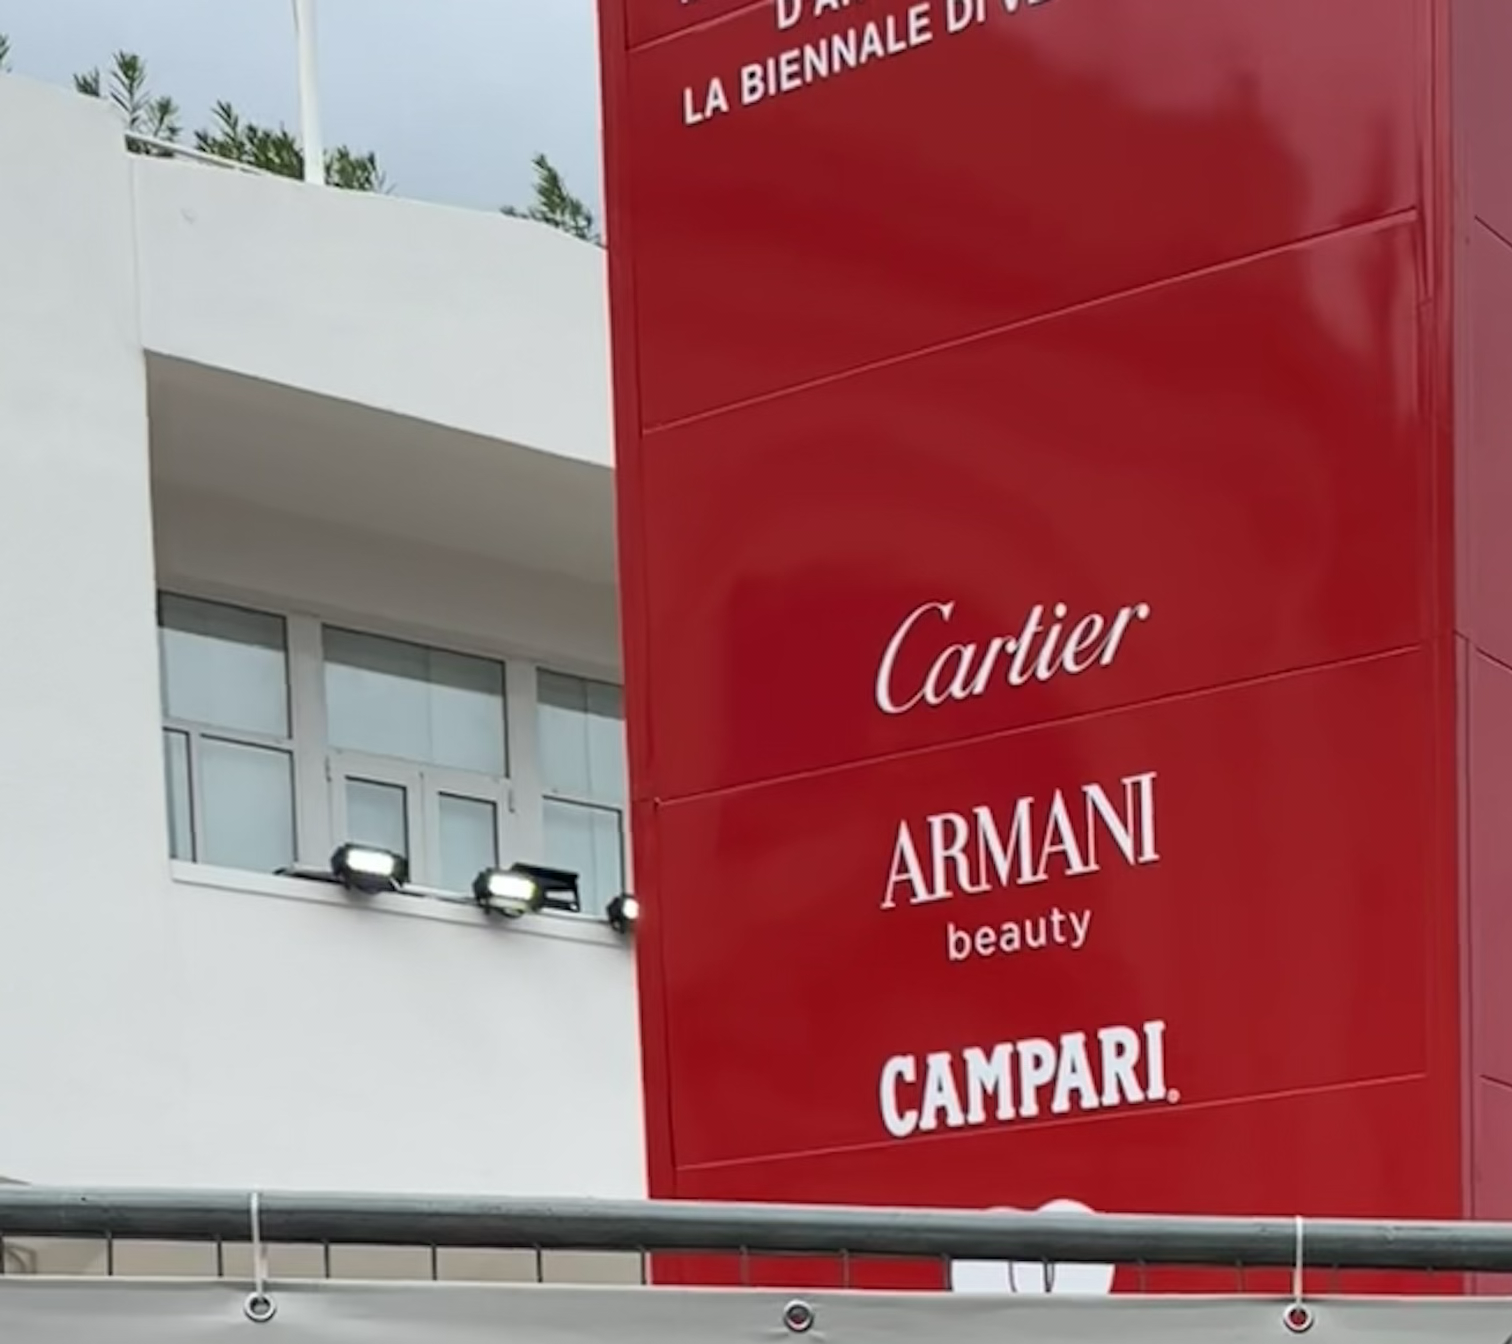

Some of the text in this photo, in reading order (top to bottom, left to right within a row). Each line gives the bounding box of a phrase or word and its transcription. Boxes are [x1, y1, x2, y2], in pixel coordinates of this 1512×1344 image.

[684, 76, 729, 124] LA
[741, 2, 933, 105] BIENNALE
[947, 0, 985, 33] DI
[876, 602, 1150, 713] Cartier
[881, 771, 1160, 908] ARMANI
[946, 905, 1091, 960] beauty
